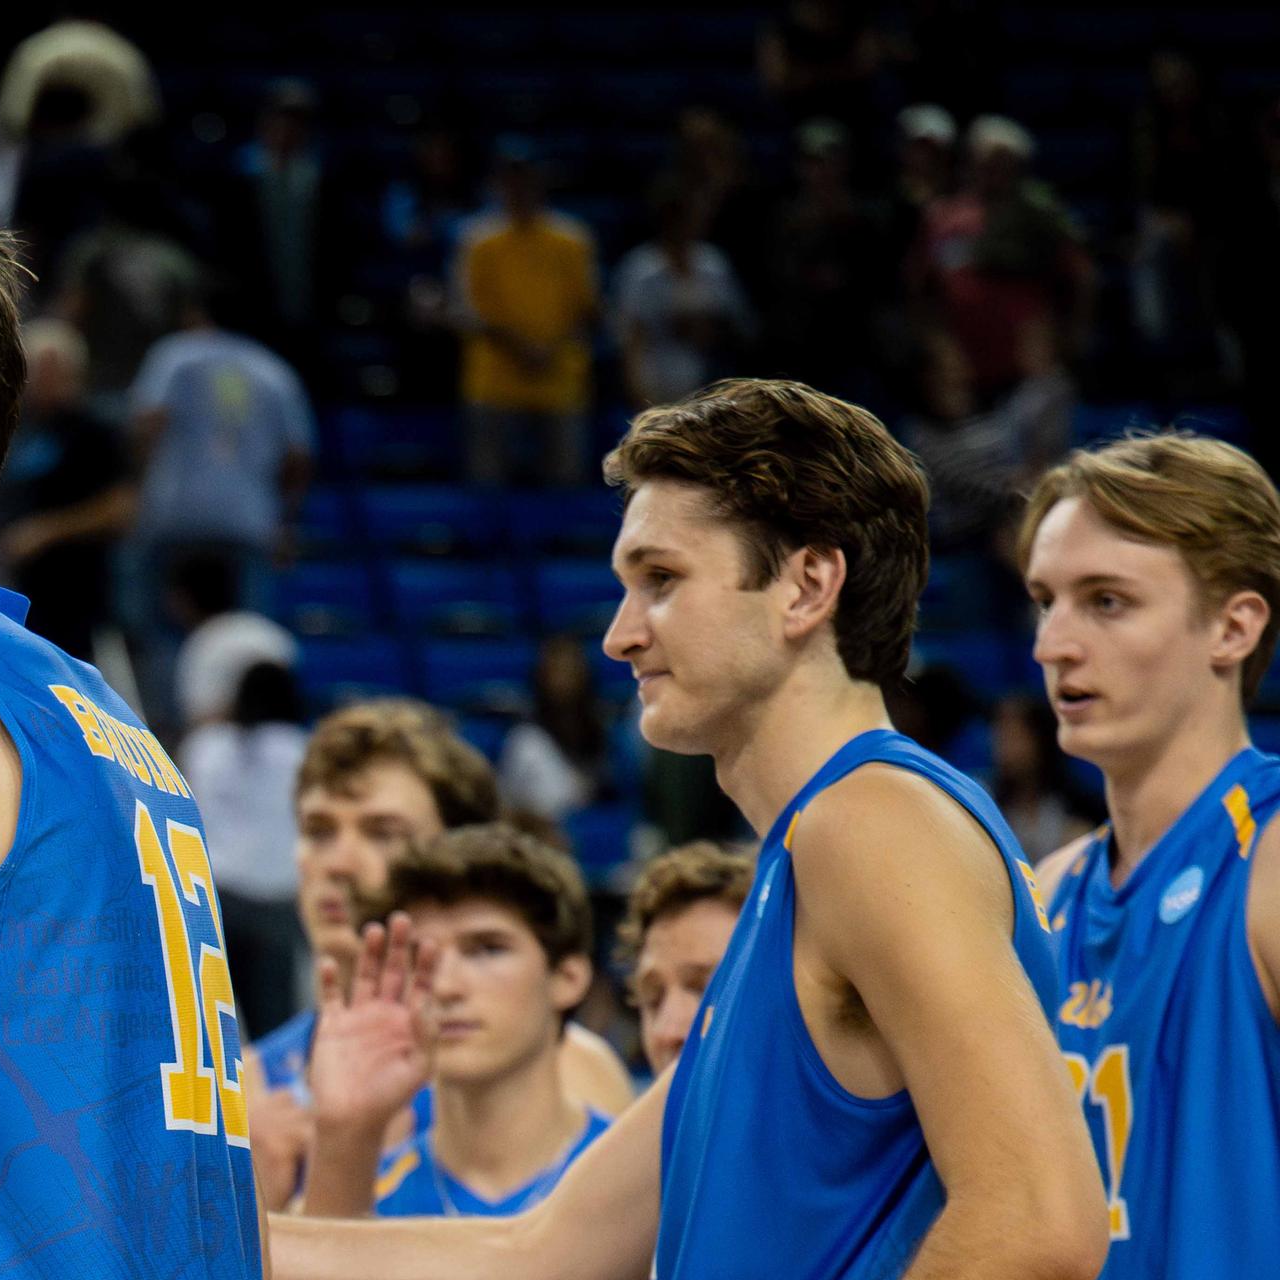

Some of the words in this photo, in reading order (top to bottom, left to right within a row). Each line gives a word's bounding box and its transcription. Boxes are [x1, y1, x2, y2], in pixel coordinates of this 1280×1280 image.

[48, 685, 196, 799] BRUIN
[134, 798, 251, 1150] 12
[1060, 1043, 1134, 1241] 1
